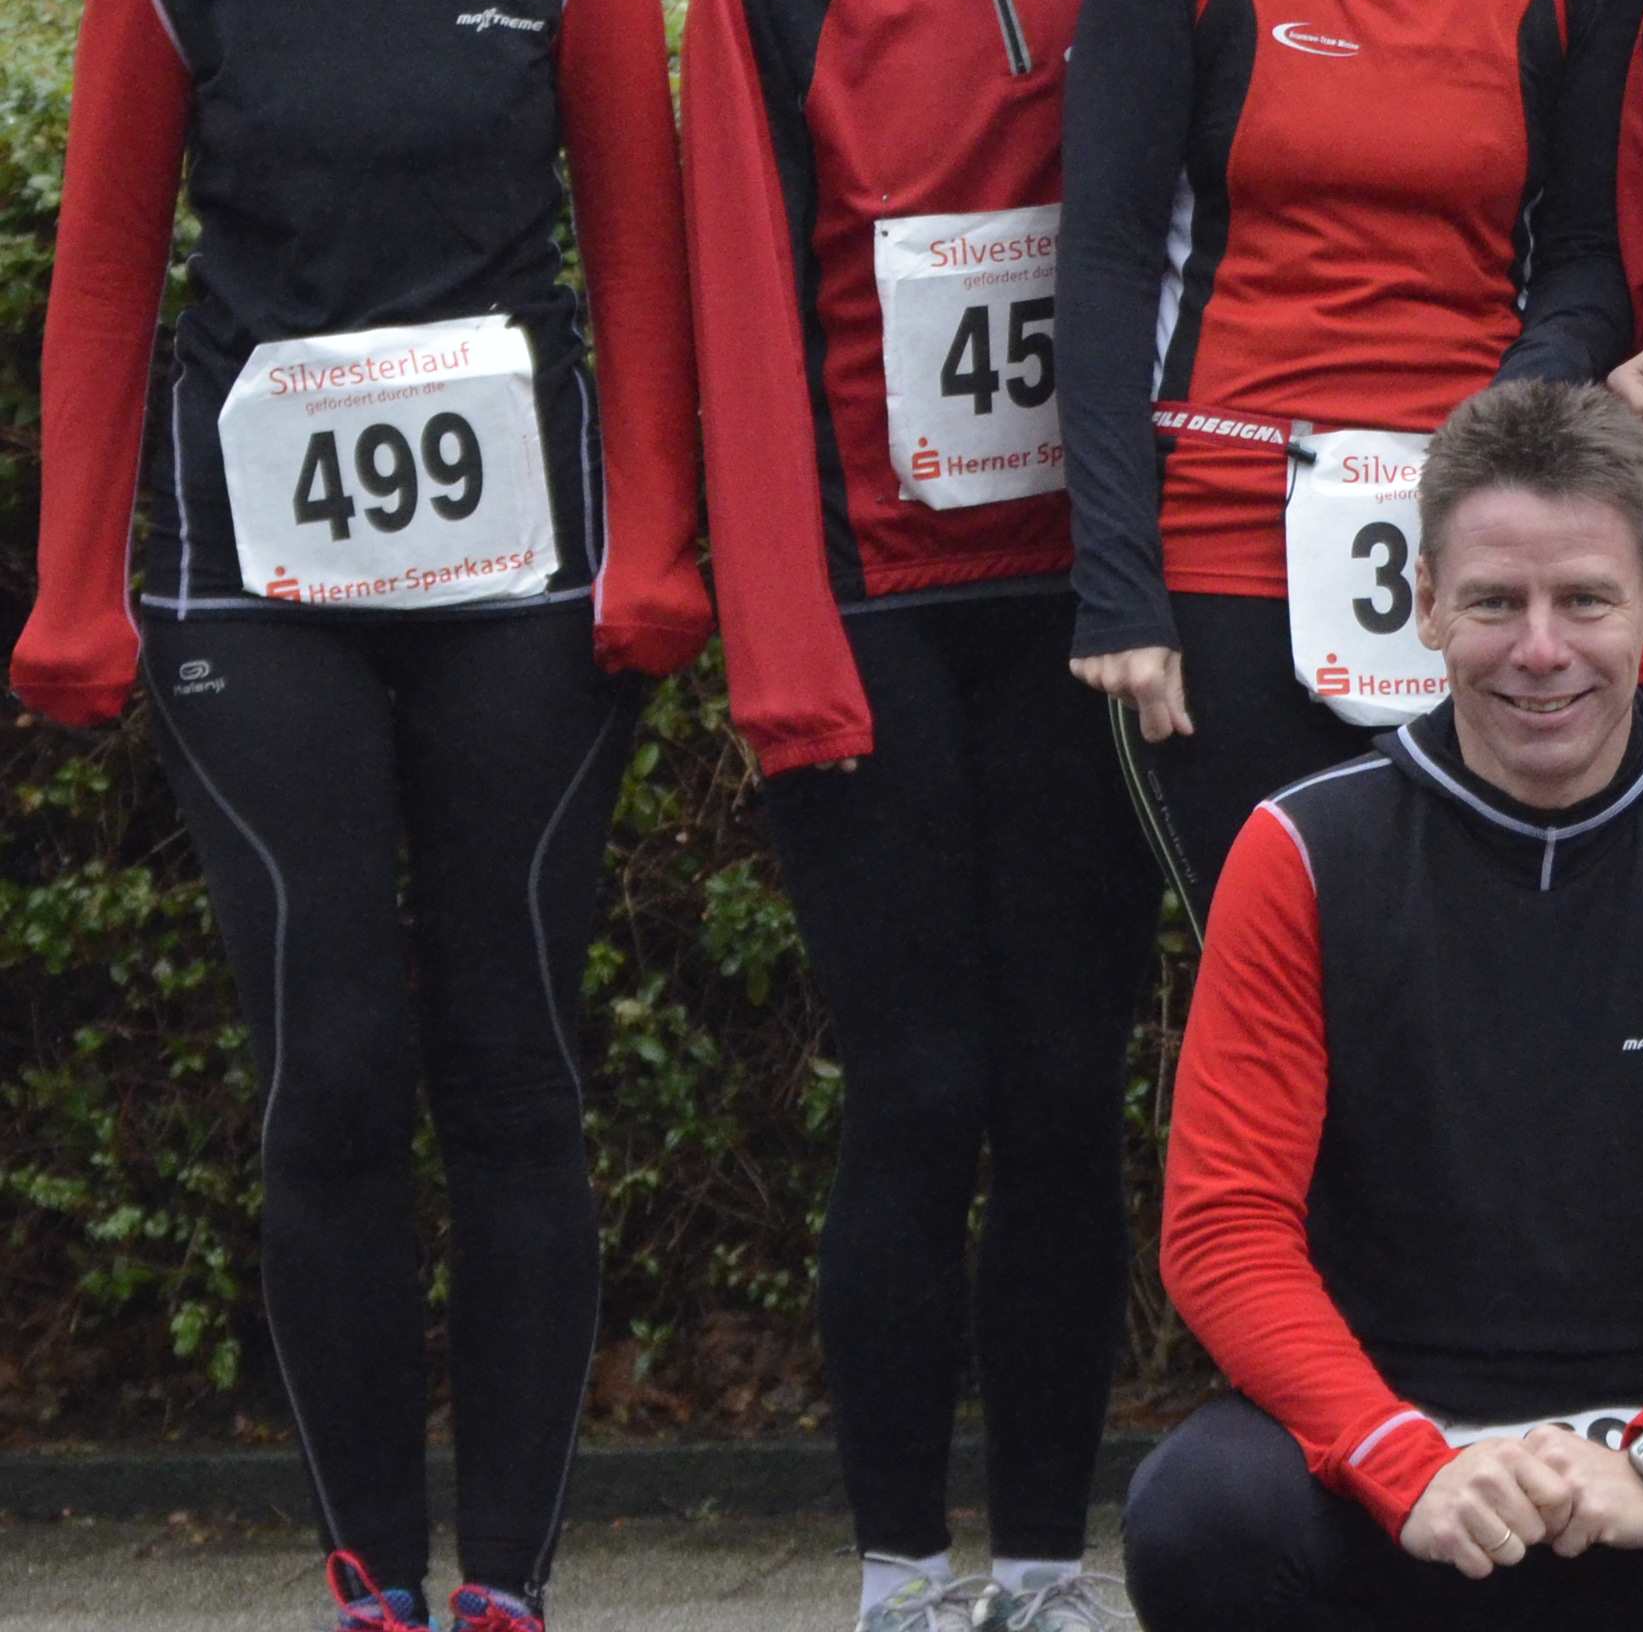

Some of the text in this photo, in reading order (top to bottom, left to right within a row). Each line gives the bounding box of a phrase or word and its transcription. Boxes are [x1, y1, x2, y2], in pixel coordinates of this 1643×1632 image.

[963, 269, 1028, 290] gefördert
[269, 340, 471, 396] Silvesterlauf
[304, 381, 447, 416] gefördert durch die
[1187, 415, 1276, 443] DESIGN
[292, 411, 484, 543] 499
[947, 450, 1030, 476] Herner
[1342, 455, 1421, 484] Silve
[308, 548, 537, 604] Herner Sparkasse
[1358, 674, 1449, 696] Herner
